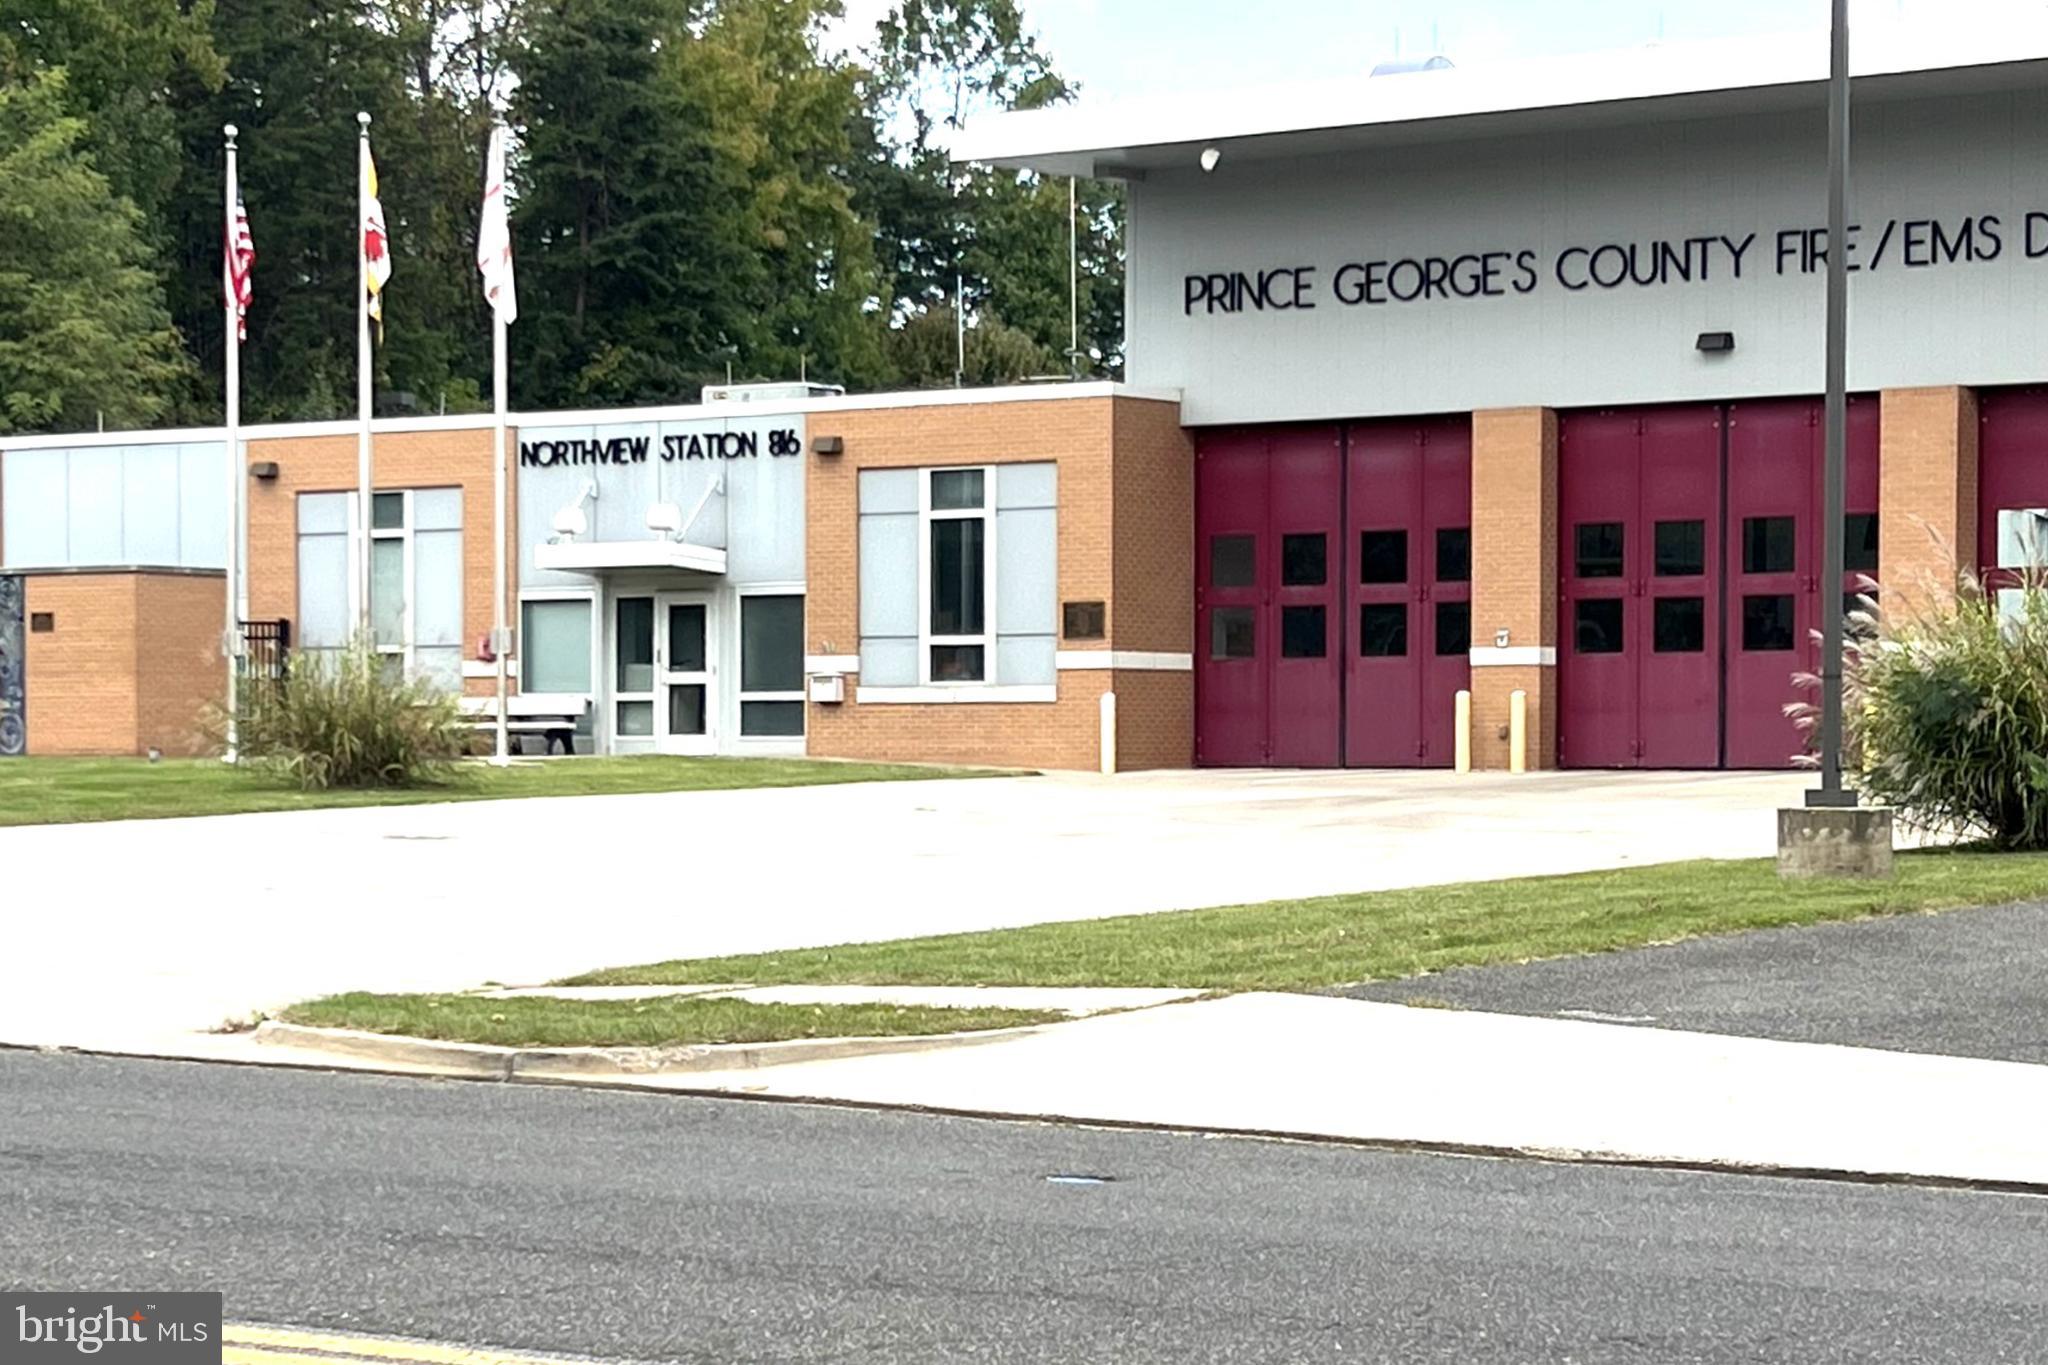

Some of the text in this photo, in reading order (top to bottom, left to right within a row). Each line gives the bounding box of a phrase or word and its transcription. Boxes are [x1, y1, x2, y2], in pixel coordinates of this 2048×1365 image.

[1184, 265, 1317, 316] PRINCE
[1333, 249, 1538, 305] GEORGE'S
[1555, 232, 1757, 291] COUNTY
[521, 436, 650, 467] NORTHVIEW
[660, 431, 757, 462] STATION
